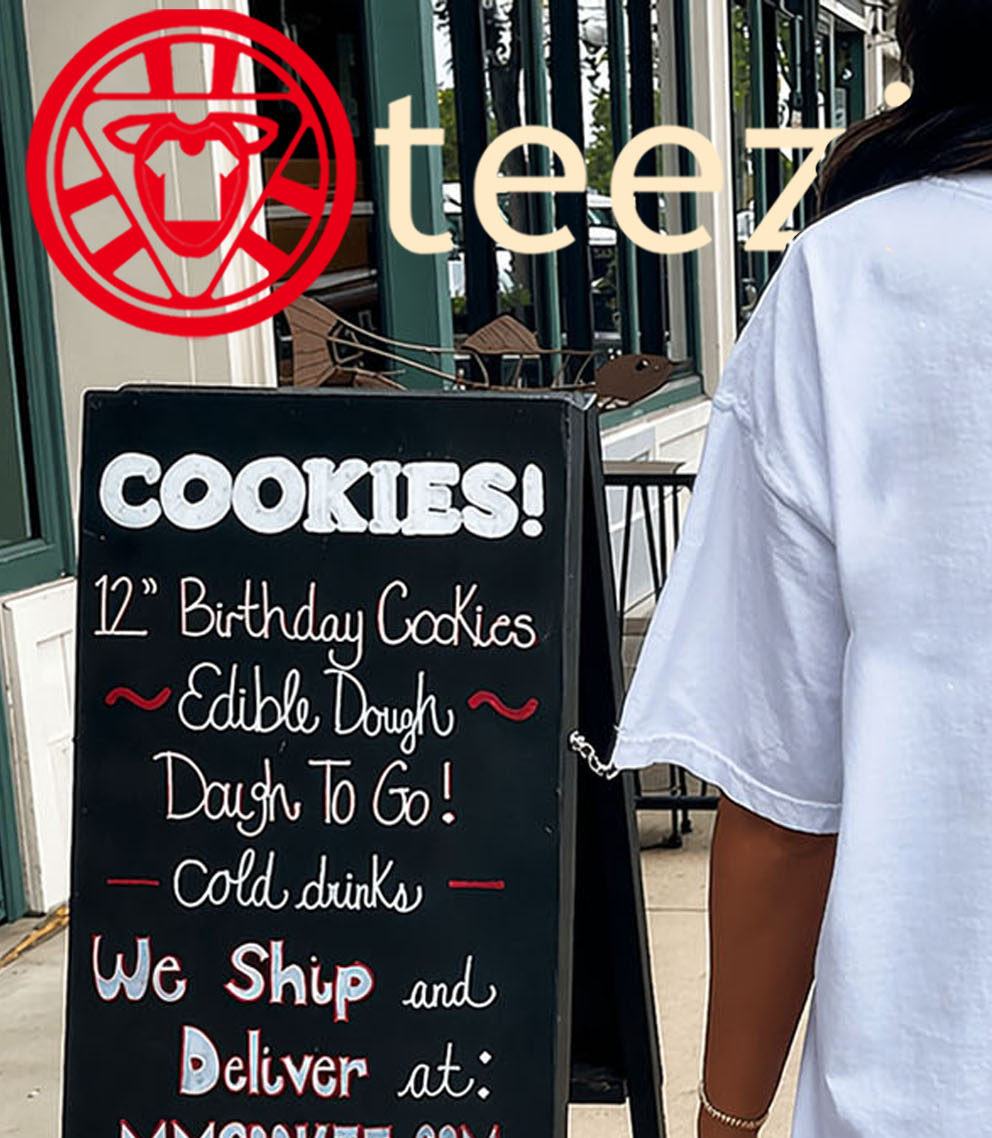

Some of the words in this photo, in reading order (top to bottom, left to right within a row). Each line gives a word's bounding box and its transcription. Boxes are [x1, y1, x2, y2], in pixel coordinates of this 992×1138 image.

[100, 452, 545, 538] COOKIES!
[180, 576, 364, 670] Birthday
[178, 662, 321, 733] Edible
[323, 666, 455, 755] Dough
[307, 758, 356, 825] To
[173, 848, 289, 909] Cold
[91, 934, 188, 1003] We
[224, 938, 375, 1023] Ship
[401, 954, 497, 1009] and
[179, 1024, 370, 1099] Deliver
[397, 1041, 493, 1100] at:
